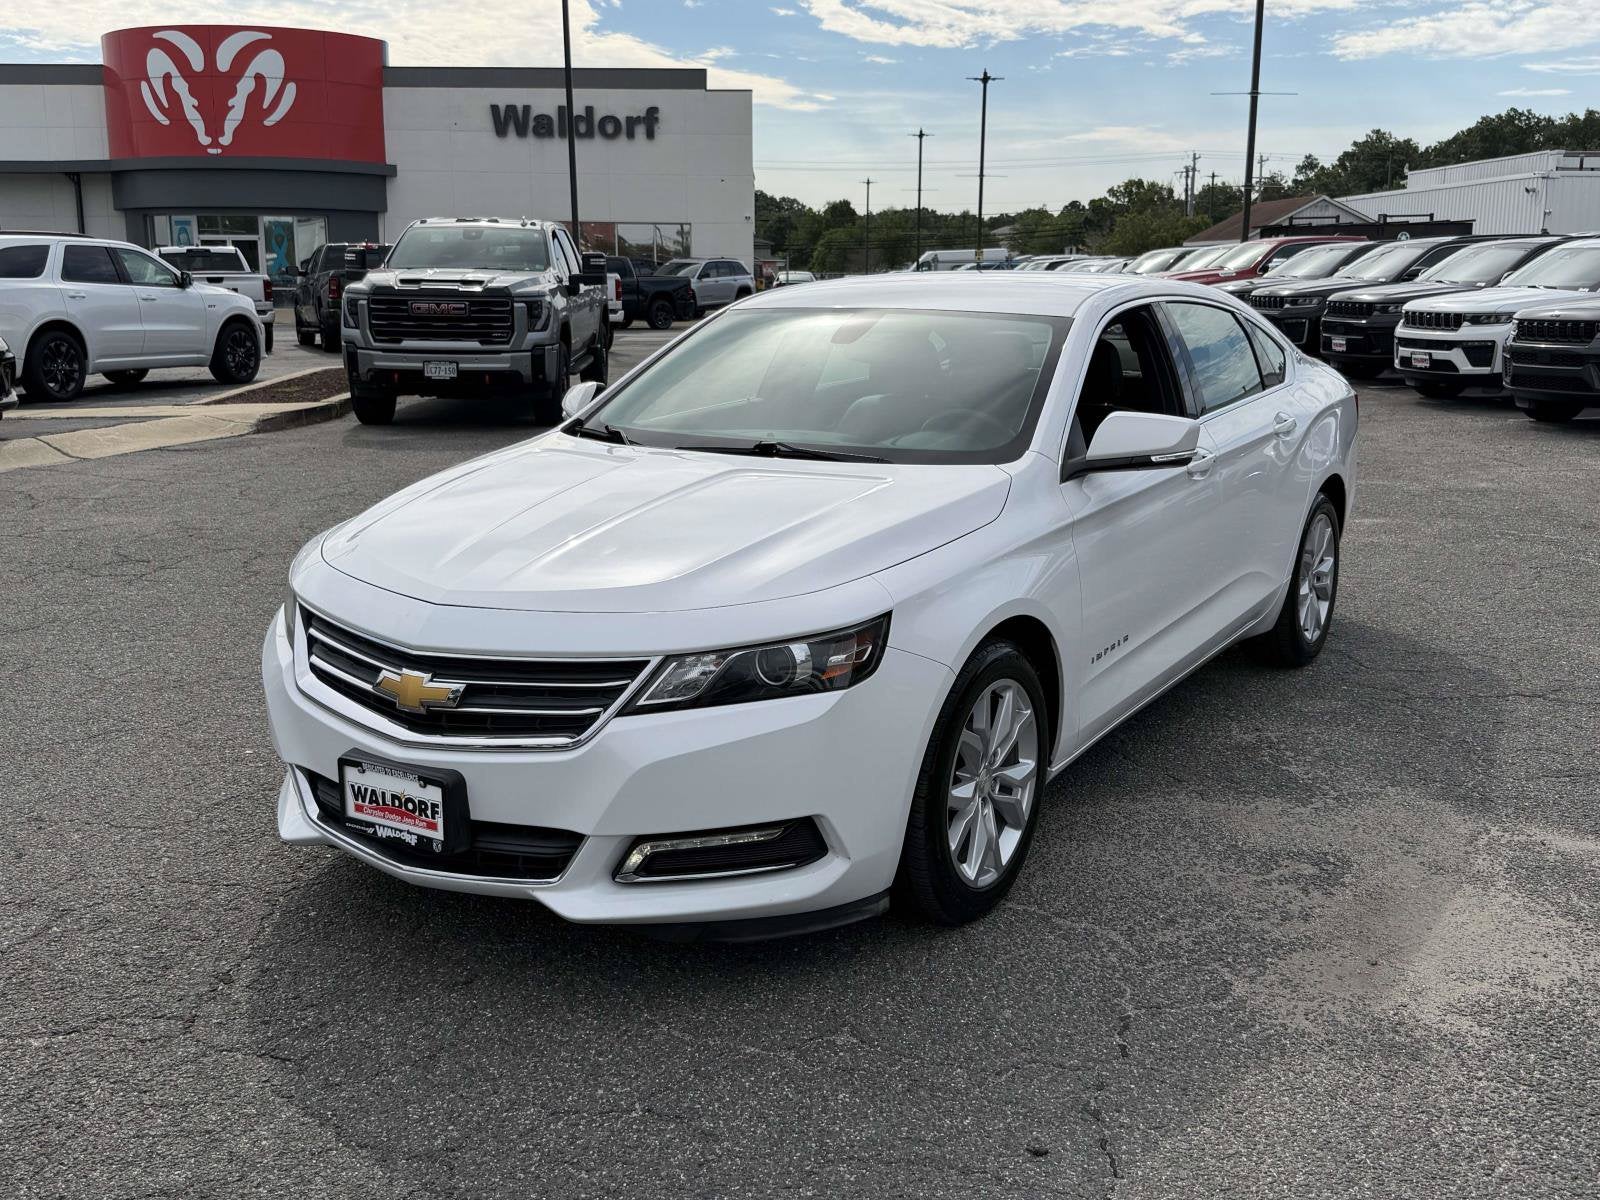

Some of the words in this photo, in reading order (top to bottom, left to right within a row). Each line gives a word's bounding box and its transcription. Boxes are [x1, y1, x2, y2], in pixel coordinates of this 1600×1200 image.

[490, 104, 659, 140] Waldorf
[412, 303, 465, 314] GMC
[350, 783, 440, 820] WALDORF
[363, 807, 384, 818] Chrysler
[384, 811, 402, 822] Dodge
[402, 816, 415, 826] Jeep
[415, 819, 427, 828] Ram
[375, 825, 418, 845] WALDORF
